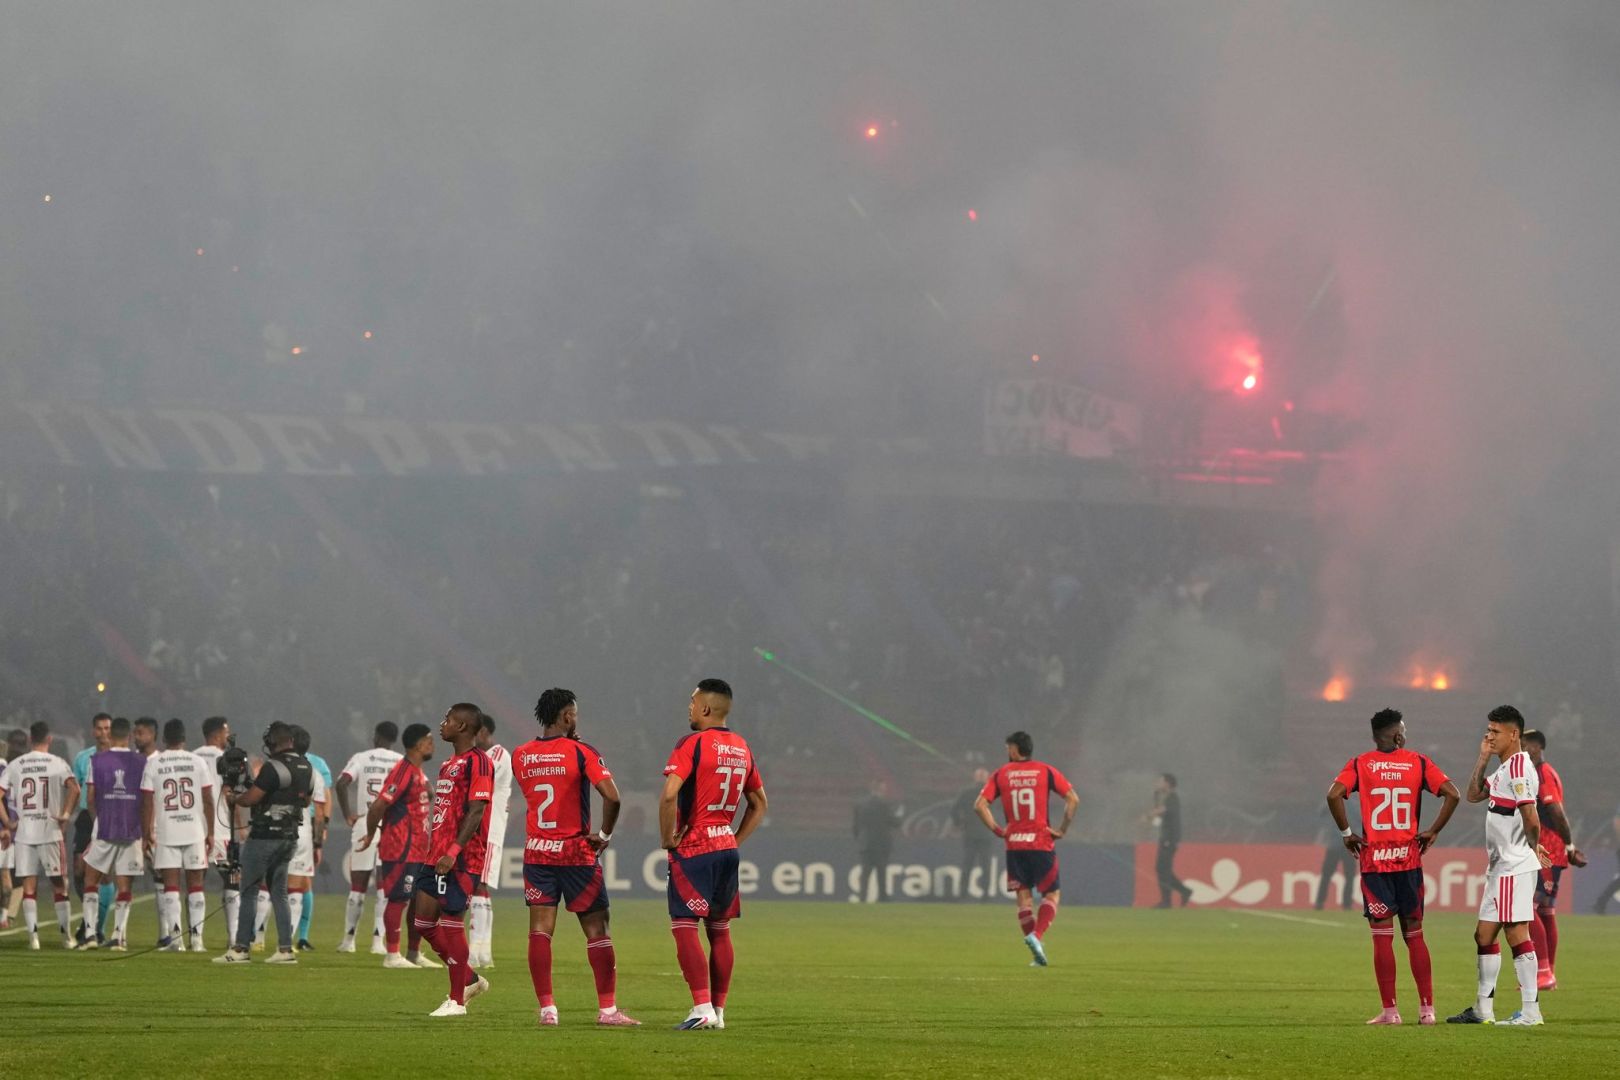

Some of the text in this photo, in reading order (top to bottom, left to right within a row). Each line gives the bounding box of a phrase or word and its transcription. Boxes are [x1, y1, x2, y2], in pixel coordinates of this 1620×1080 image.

[21, 776, 49, 810] 21
[707, 766, 747, 812] 33
[1380, 772, 1402, 780] MENA
[162, 776, 195, 811] 26
[533, 783, 557, 829] 2
[1010, 788, 1035, 821] 19
[1370, 787, 1412, 831] 26
[526, 838, 565, 853] MAPEI
[1373, 846, 1409, 861] MAPEI
[772, 861, 836, 895] en
